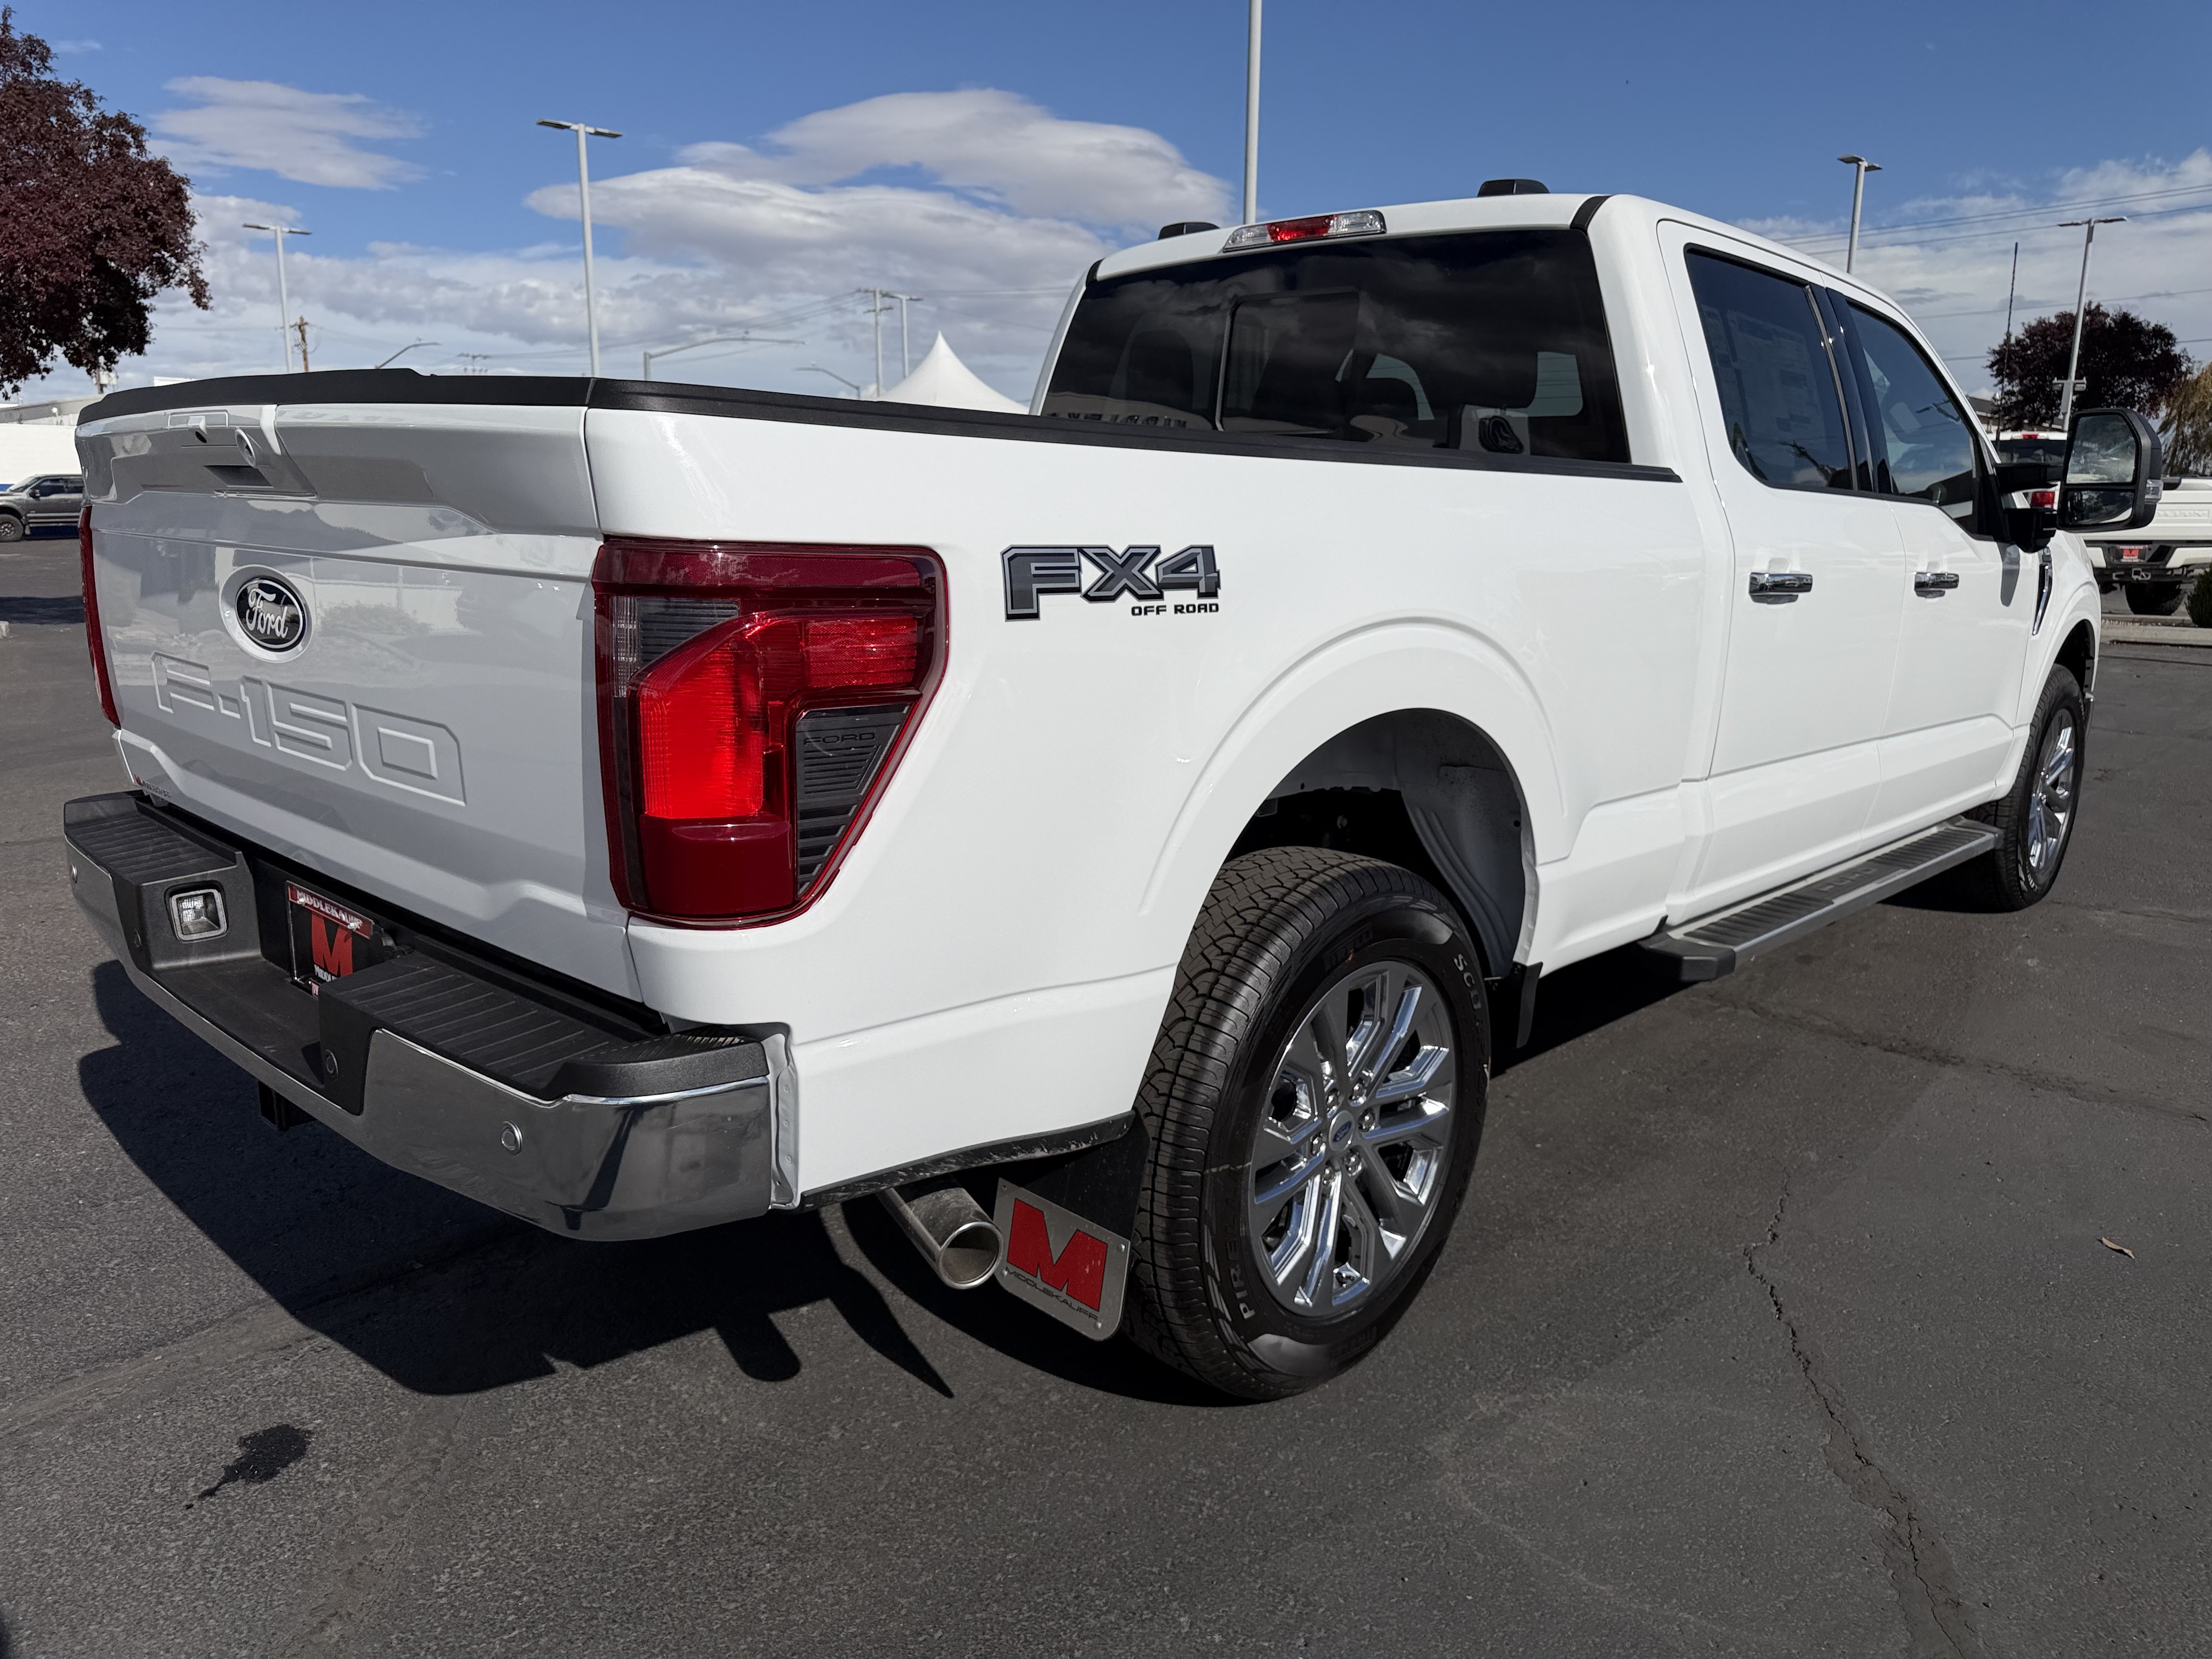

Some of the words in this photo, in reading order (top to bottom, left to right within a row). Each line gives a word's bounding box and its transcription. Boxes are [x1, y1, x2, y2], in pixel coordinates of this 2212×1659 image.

[1000, 544, 1221, 622] FX4
[1131, 605, 1167, 617] OFF
[1173, 603, 1219, 615] ROAD
[246, 588, 288, 639] Ford
[151, 651, 466, 806] F-150
[803, 732, 876, 746] FORD
[312, 911, 353, 977] M
[1007, 1198, 1108, 1312] M
[1005, 1266, 1099, 1321] MIDDLEKAUFF
